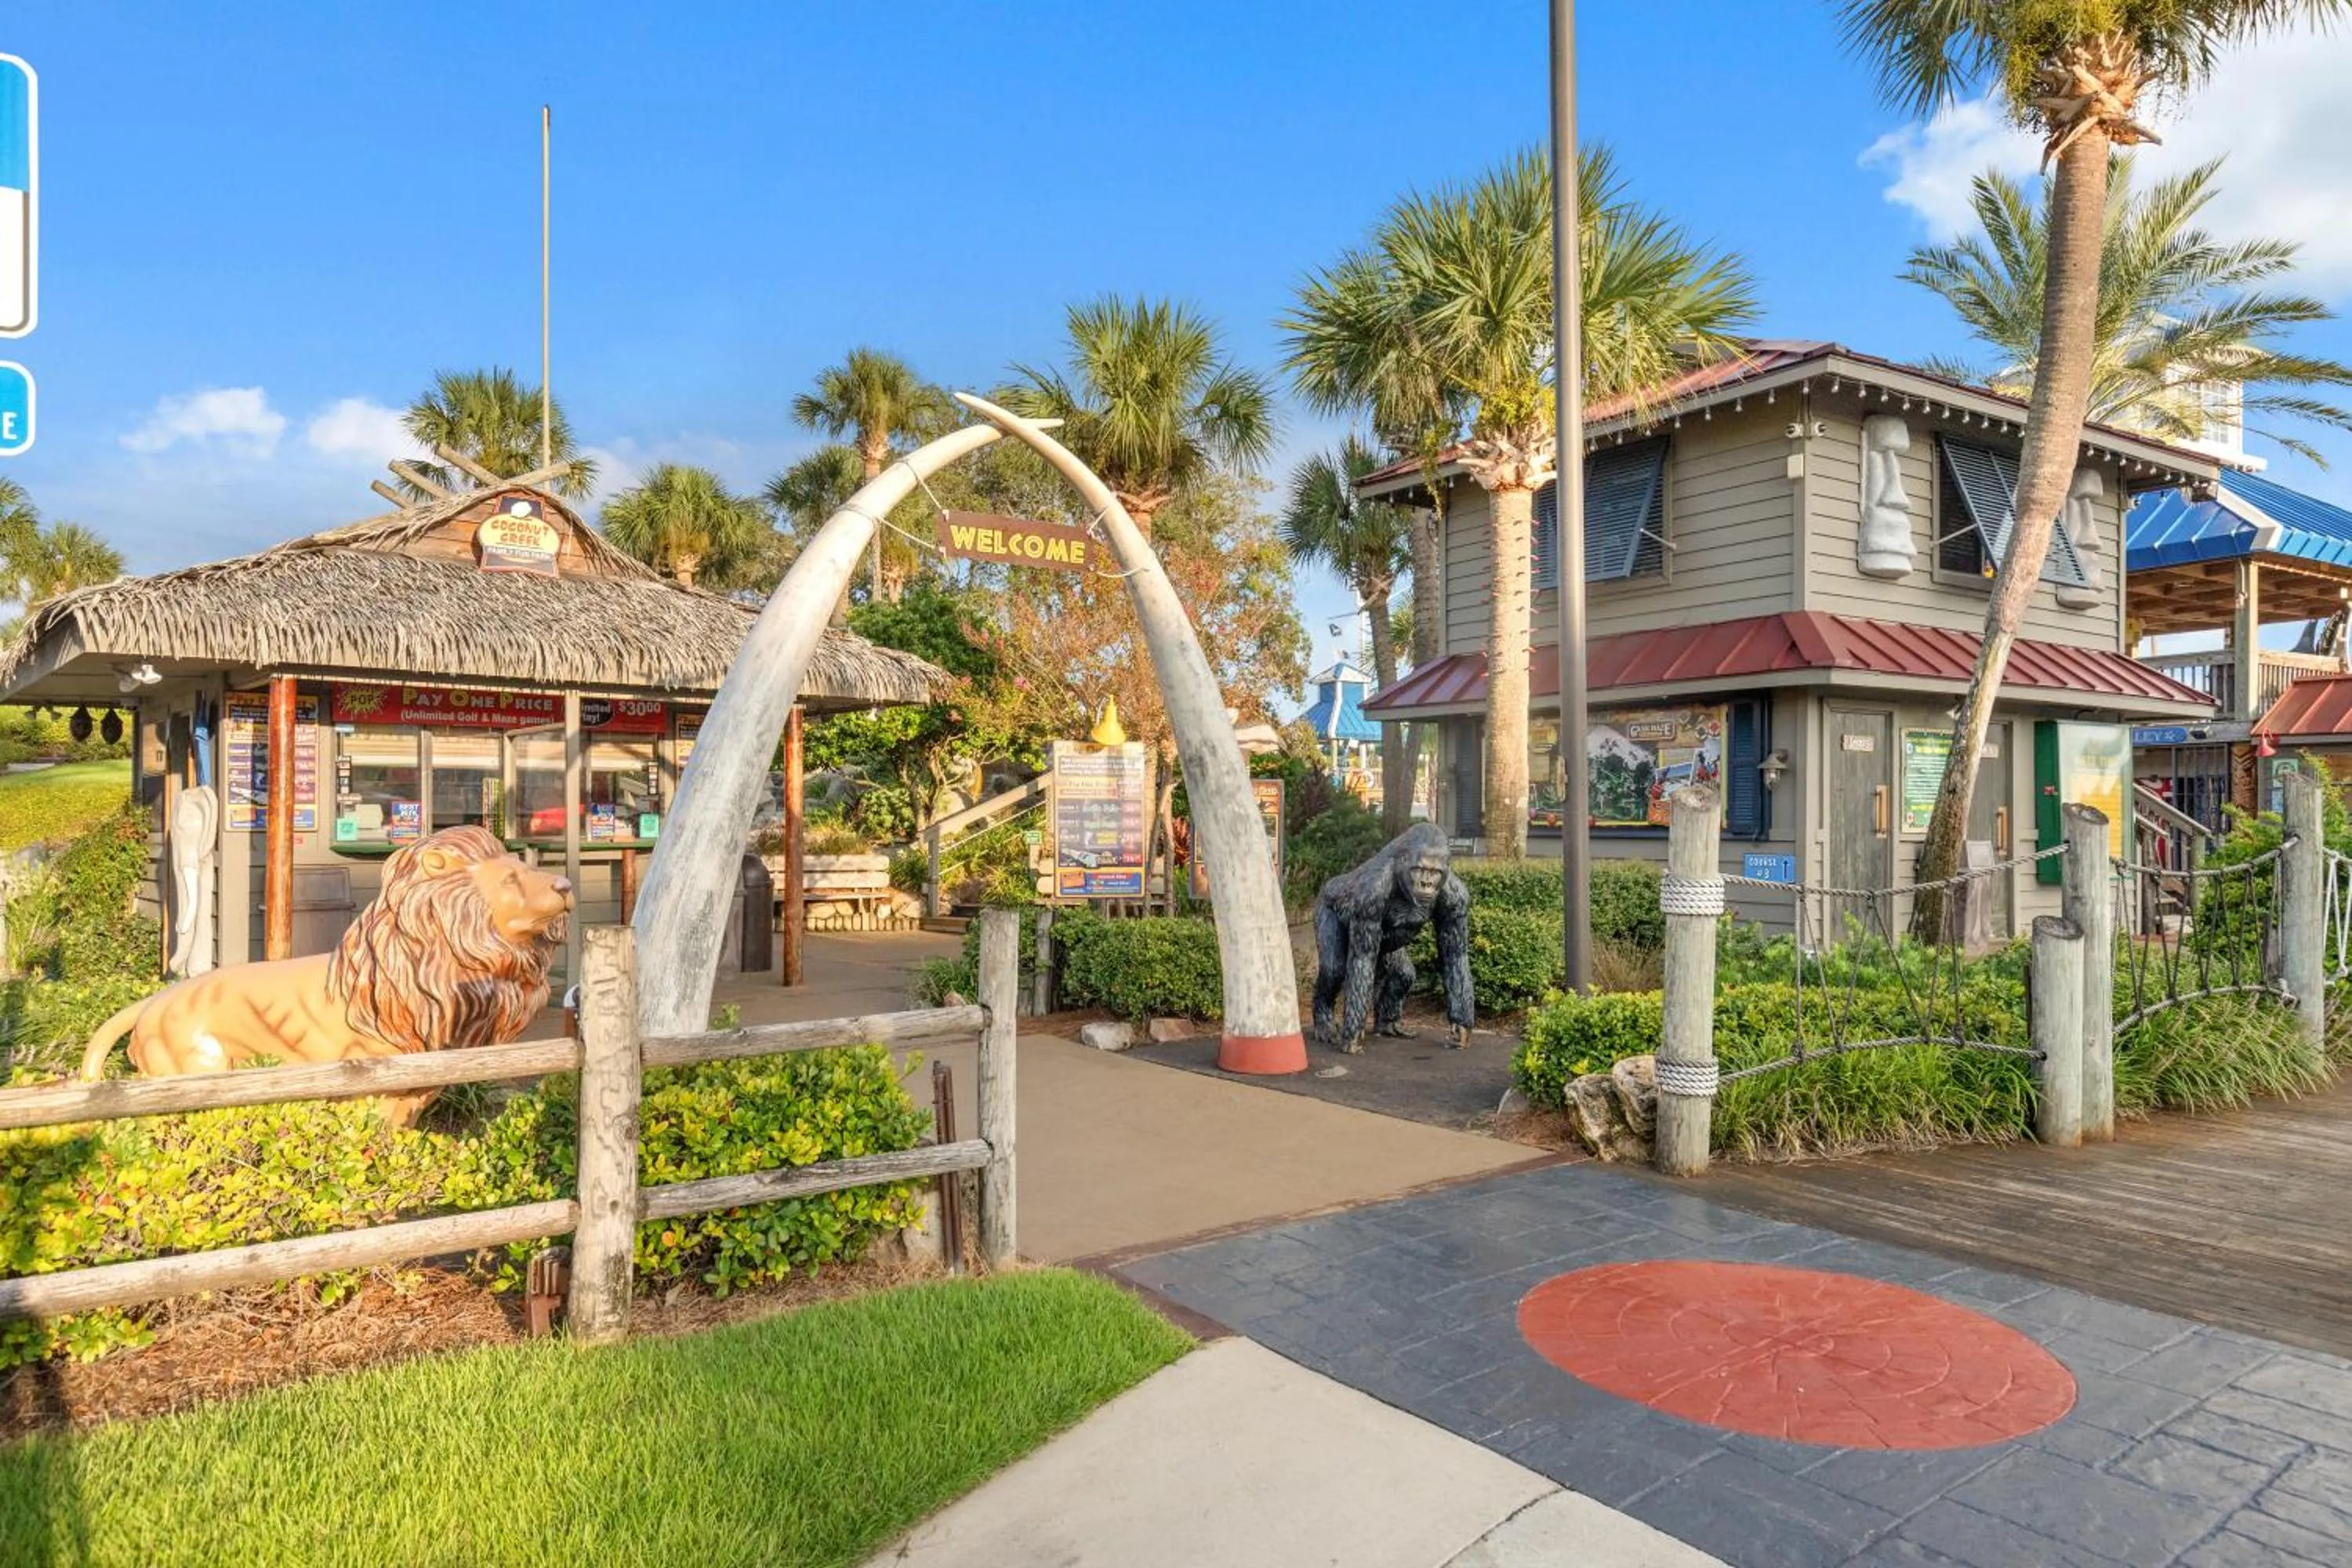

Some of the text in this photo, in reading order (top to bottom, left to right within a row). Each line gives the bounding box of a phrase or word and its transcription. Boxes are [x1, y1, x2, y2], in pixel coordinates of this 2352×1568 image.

[3, 412, 17, 439] E
[491, 520, 550, 536] COCONUT
[499, 532, 541, 546] CREEK
[949, 524, 1087, 564] WELCOME
[350, 695, 375, 705] POP
[457, 710, 478, 722] Golf
[482, 712, 490, 722] &
[1748, 856, 1777, 866] COURSE
